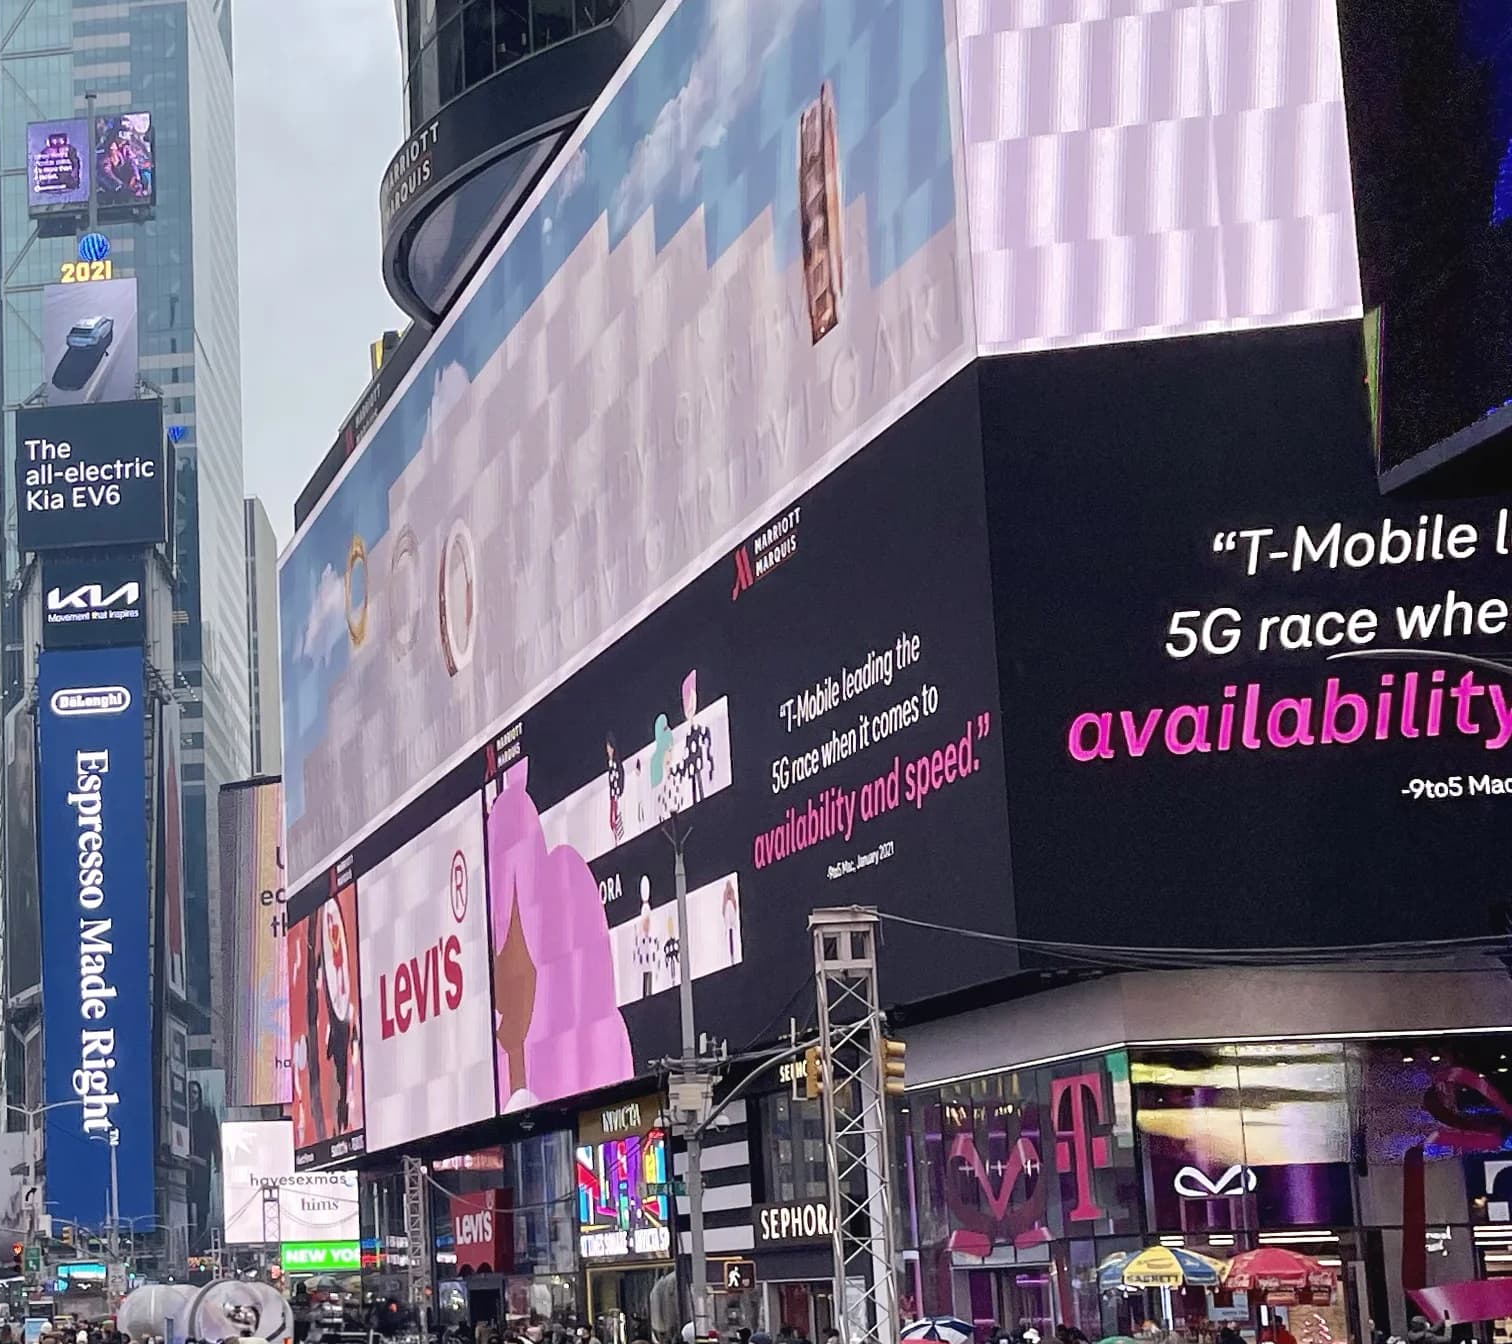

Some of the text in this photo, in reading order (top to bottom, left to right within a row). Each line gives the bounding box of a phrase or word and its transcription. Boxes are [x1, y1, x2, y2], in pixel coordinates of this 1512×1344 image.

[61, 260, 112, 283] 2021
[25, 440, 71, 461] The
[26, 458, 154, 486] all-electric
[27, 484, 120, 512] Kia EV6
[754, 507, 802, 554] MARRIOTT
[756, 534, 797, 576] MARQUIS
[48, 582, 139, 610] KIA
[1165, 607, 1241, 660] 5G
[1258, 607, 1378, 651] race
[842, 648, 893, 700] leading
[895, 632, 920, 671] the
[1067, 669, 1512, 762] availability
[771, 685, 939, 794] 5G race when it comes to
[1400, 776, 1462, 800] -9to5
[68, 748, 110, 909] Espresso
[754, 786, 855, 870] availability
[860, 756, 899, 822] and
[879, 841, 894, 860] 2021
[79, 919, 117, 1019] Made
[301, 1197, 338, 1211] hims
[285, 1250, 325, 1263] NEW
